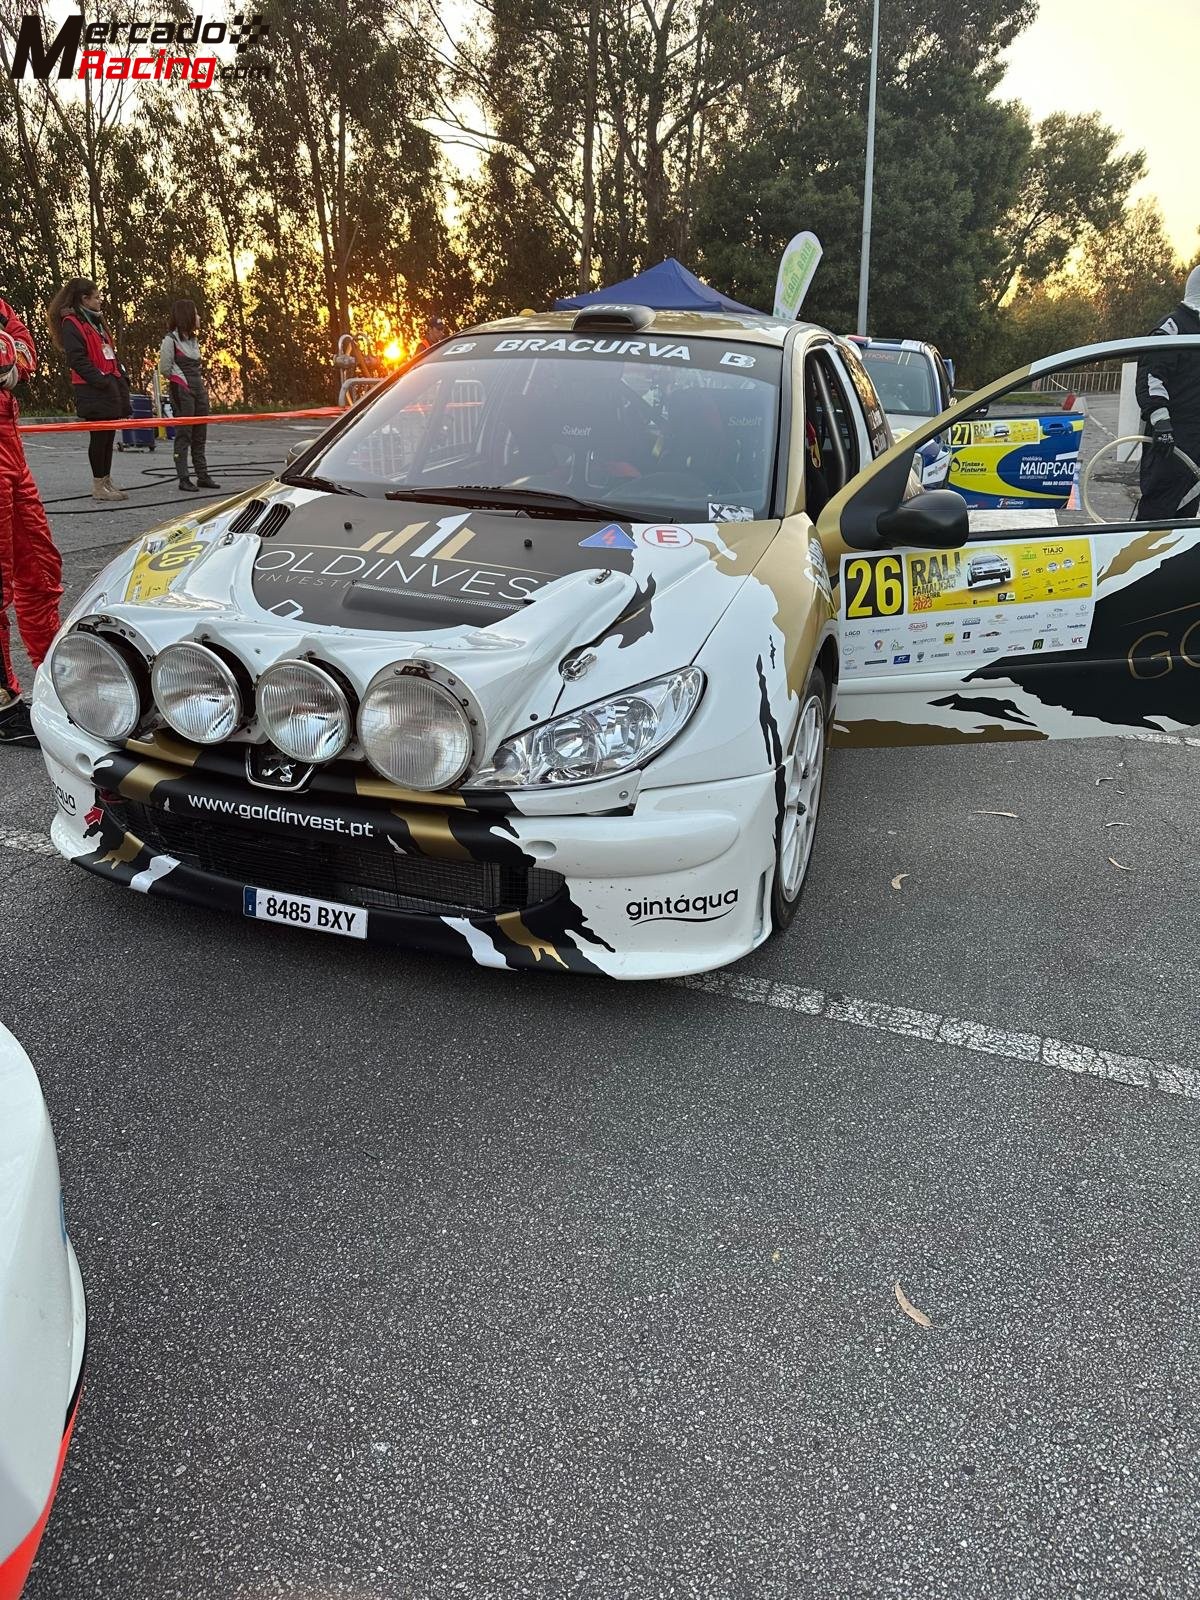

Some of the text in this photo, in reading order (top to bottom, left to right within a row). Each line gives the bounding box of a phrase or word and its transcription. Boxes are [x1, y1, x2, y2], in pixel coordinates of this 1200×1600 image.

[494, 338, 691, 360] BRACURVA
[952, 424, 970, 445] 27
[656, 530, 680, 544] E
[847, 556, 902, 617] 26
[912, 600, 933, 611] 2023
[188, 794, 374, 837] www.goldinvest.pt
[266, 897, 356, 932] 8485 BXY
[626, 888, 739, 921] gintáqua
